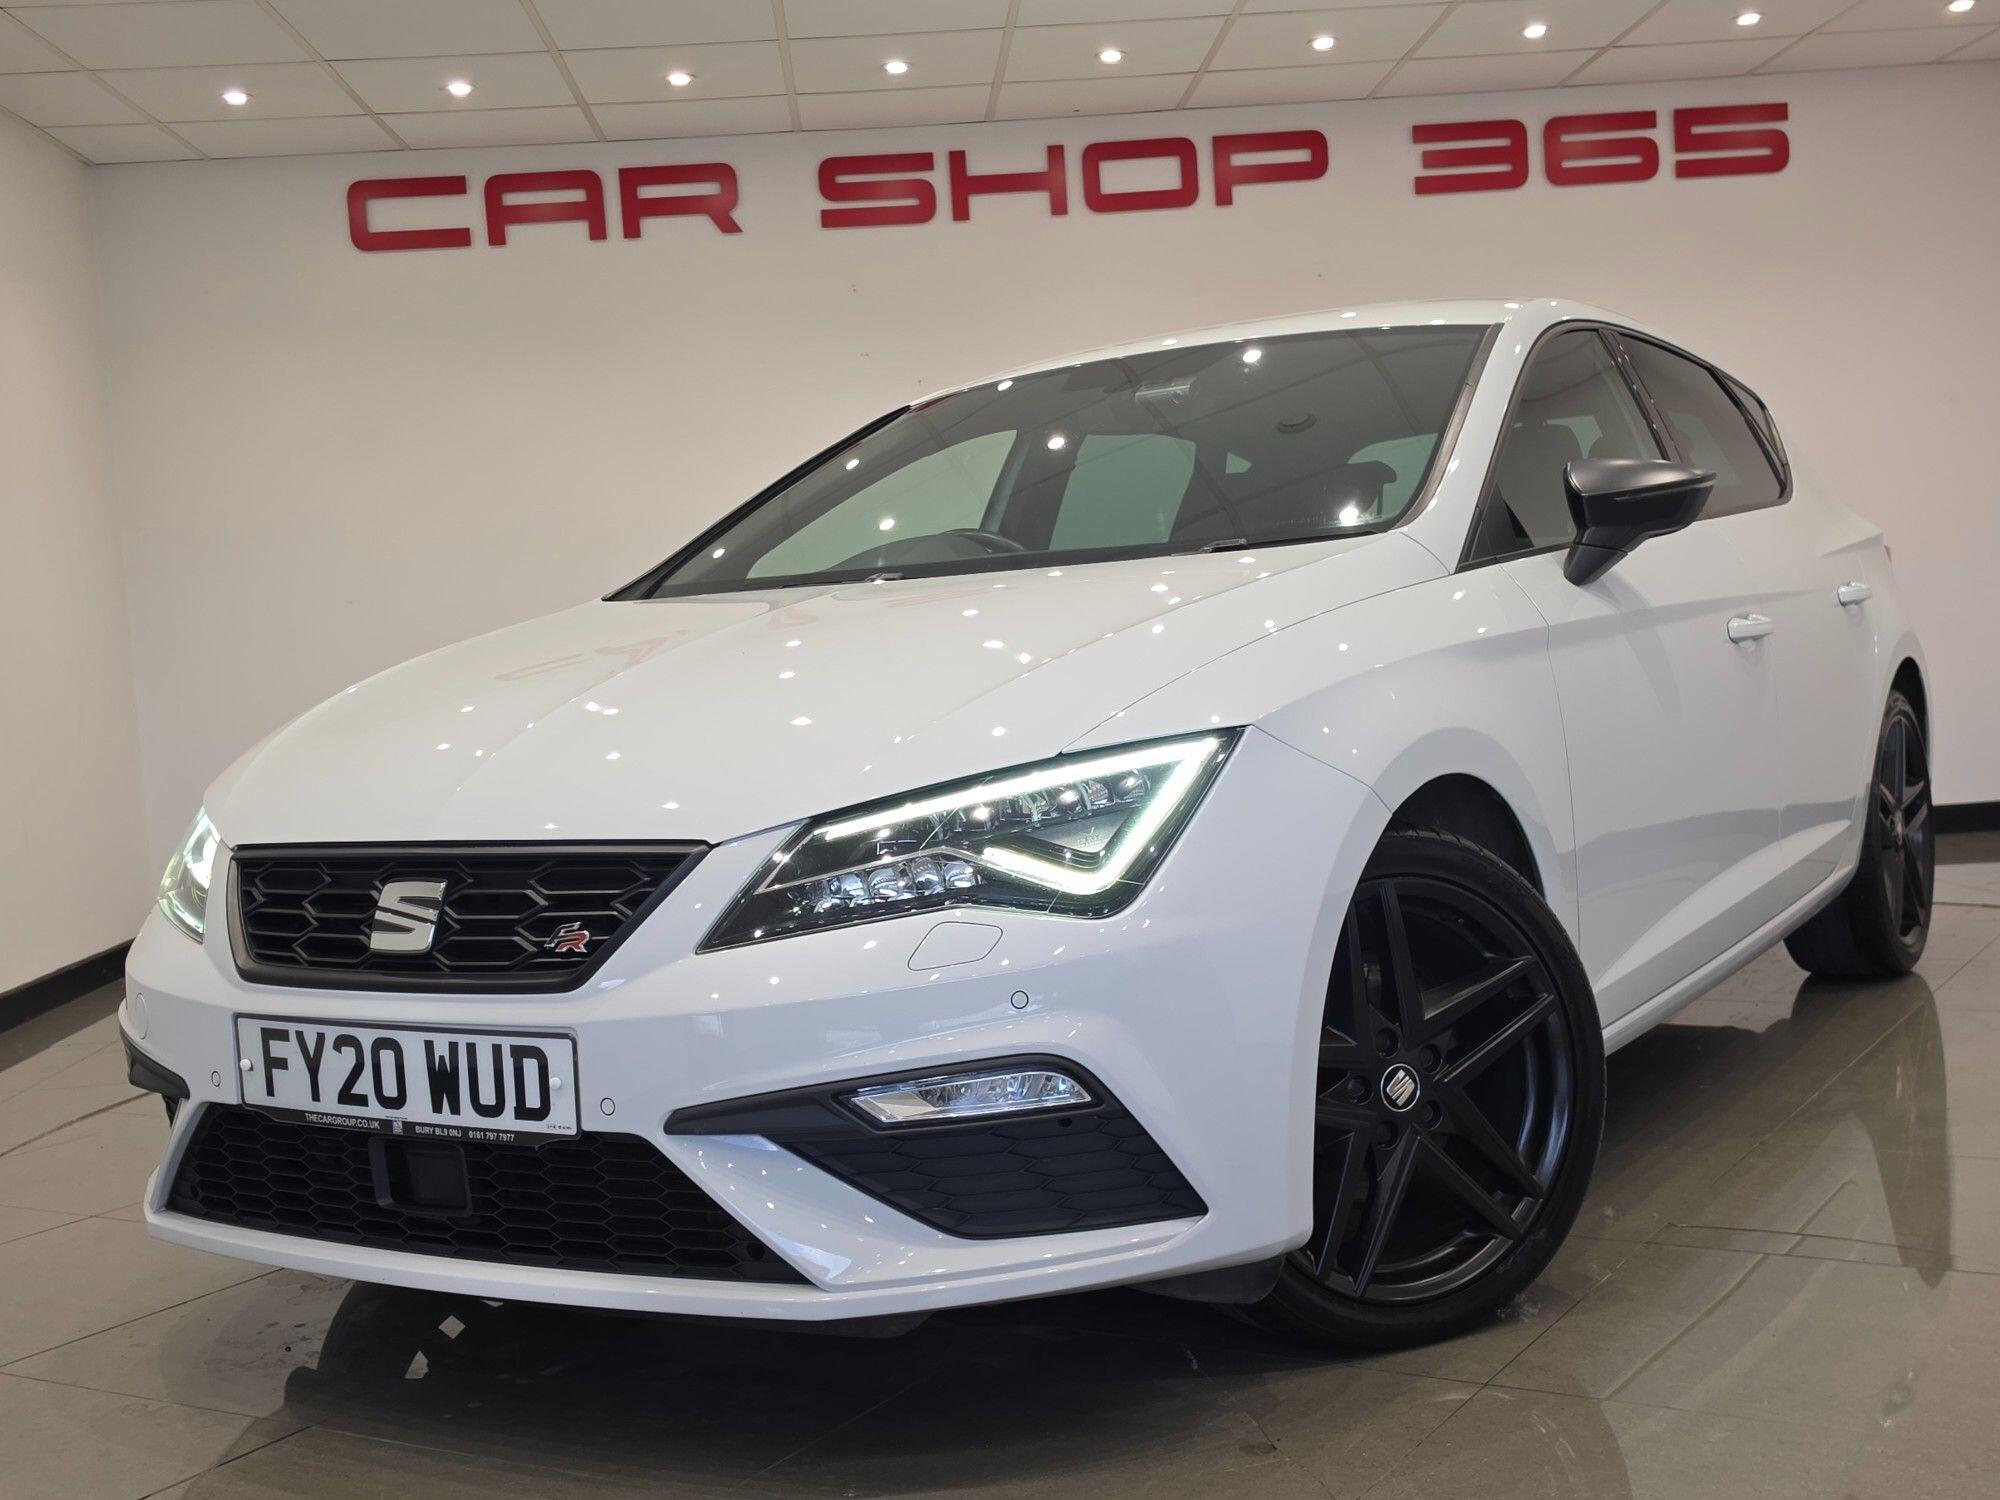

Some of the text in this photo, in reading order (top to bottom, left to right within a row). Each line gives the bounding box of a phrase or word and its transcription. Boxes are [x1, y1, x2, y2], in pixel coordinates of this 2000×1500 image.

[347, 103, 1790, 251] CAR SHOP 365
[260, 1027, 551, 1122] FY20 WUD
[305, 1113, 380, 1130] THECARGROUP.CO.UK
[415, 1125, 434, 1134] BURY
[435, 1127, 447, 1136] BL9
[469, 1130, 484, 1139] 0161
